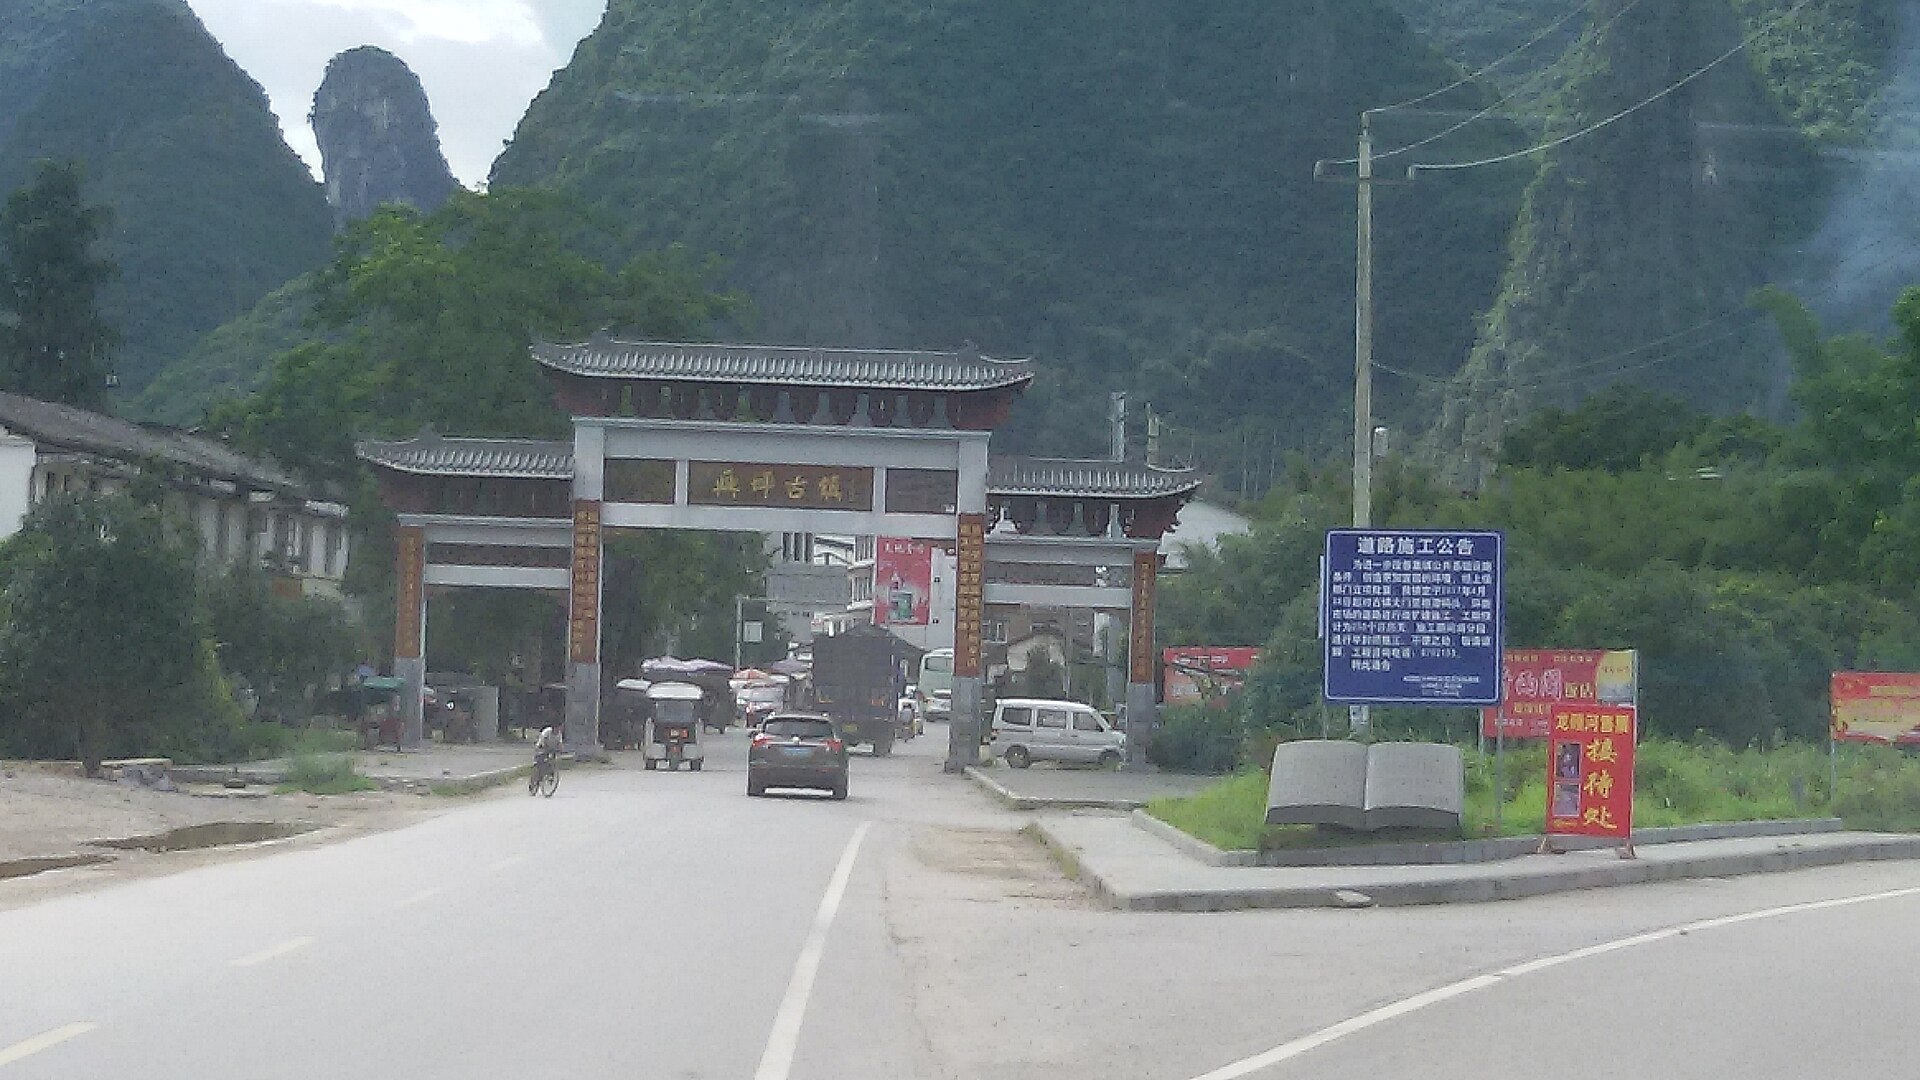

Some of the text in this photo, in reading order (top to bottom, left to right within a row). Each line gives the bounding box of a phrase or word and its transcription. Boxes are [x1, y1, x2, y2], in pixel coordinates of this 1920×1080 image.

[1358, 536, 1474, 555] 道路施工公告
[1583, 738, 1618, 829] 接待处
